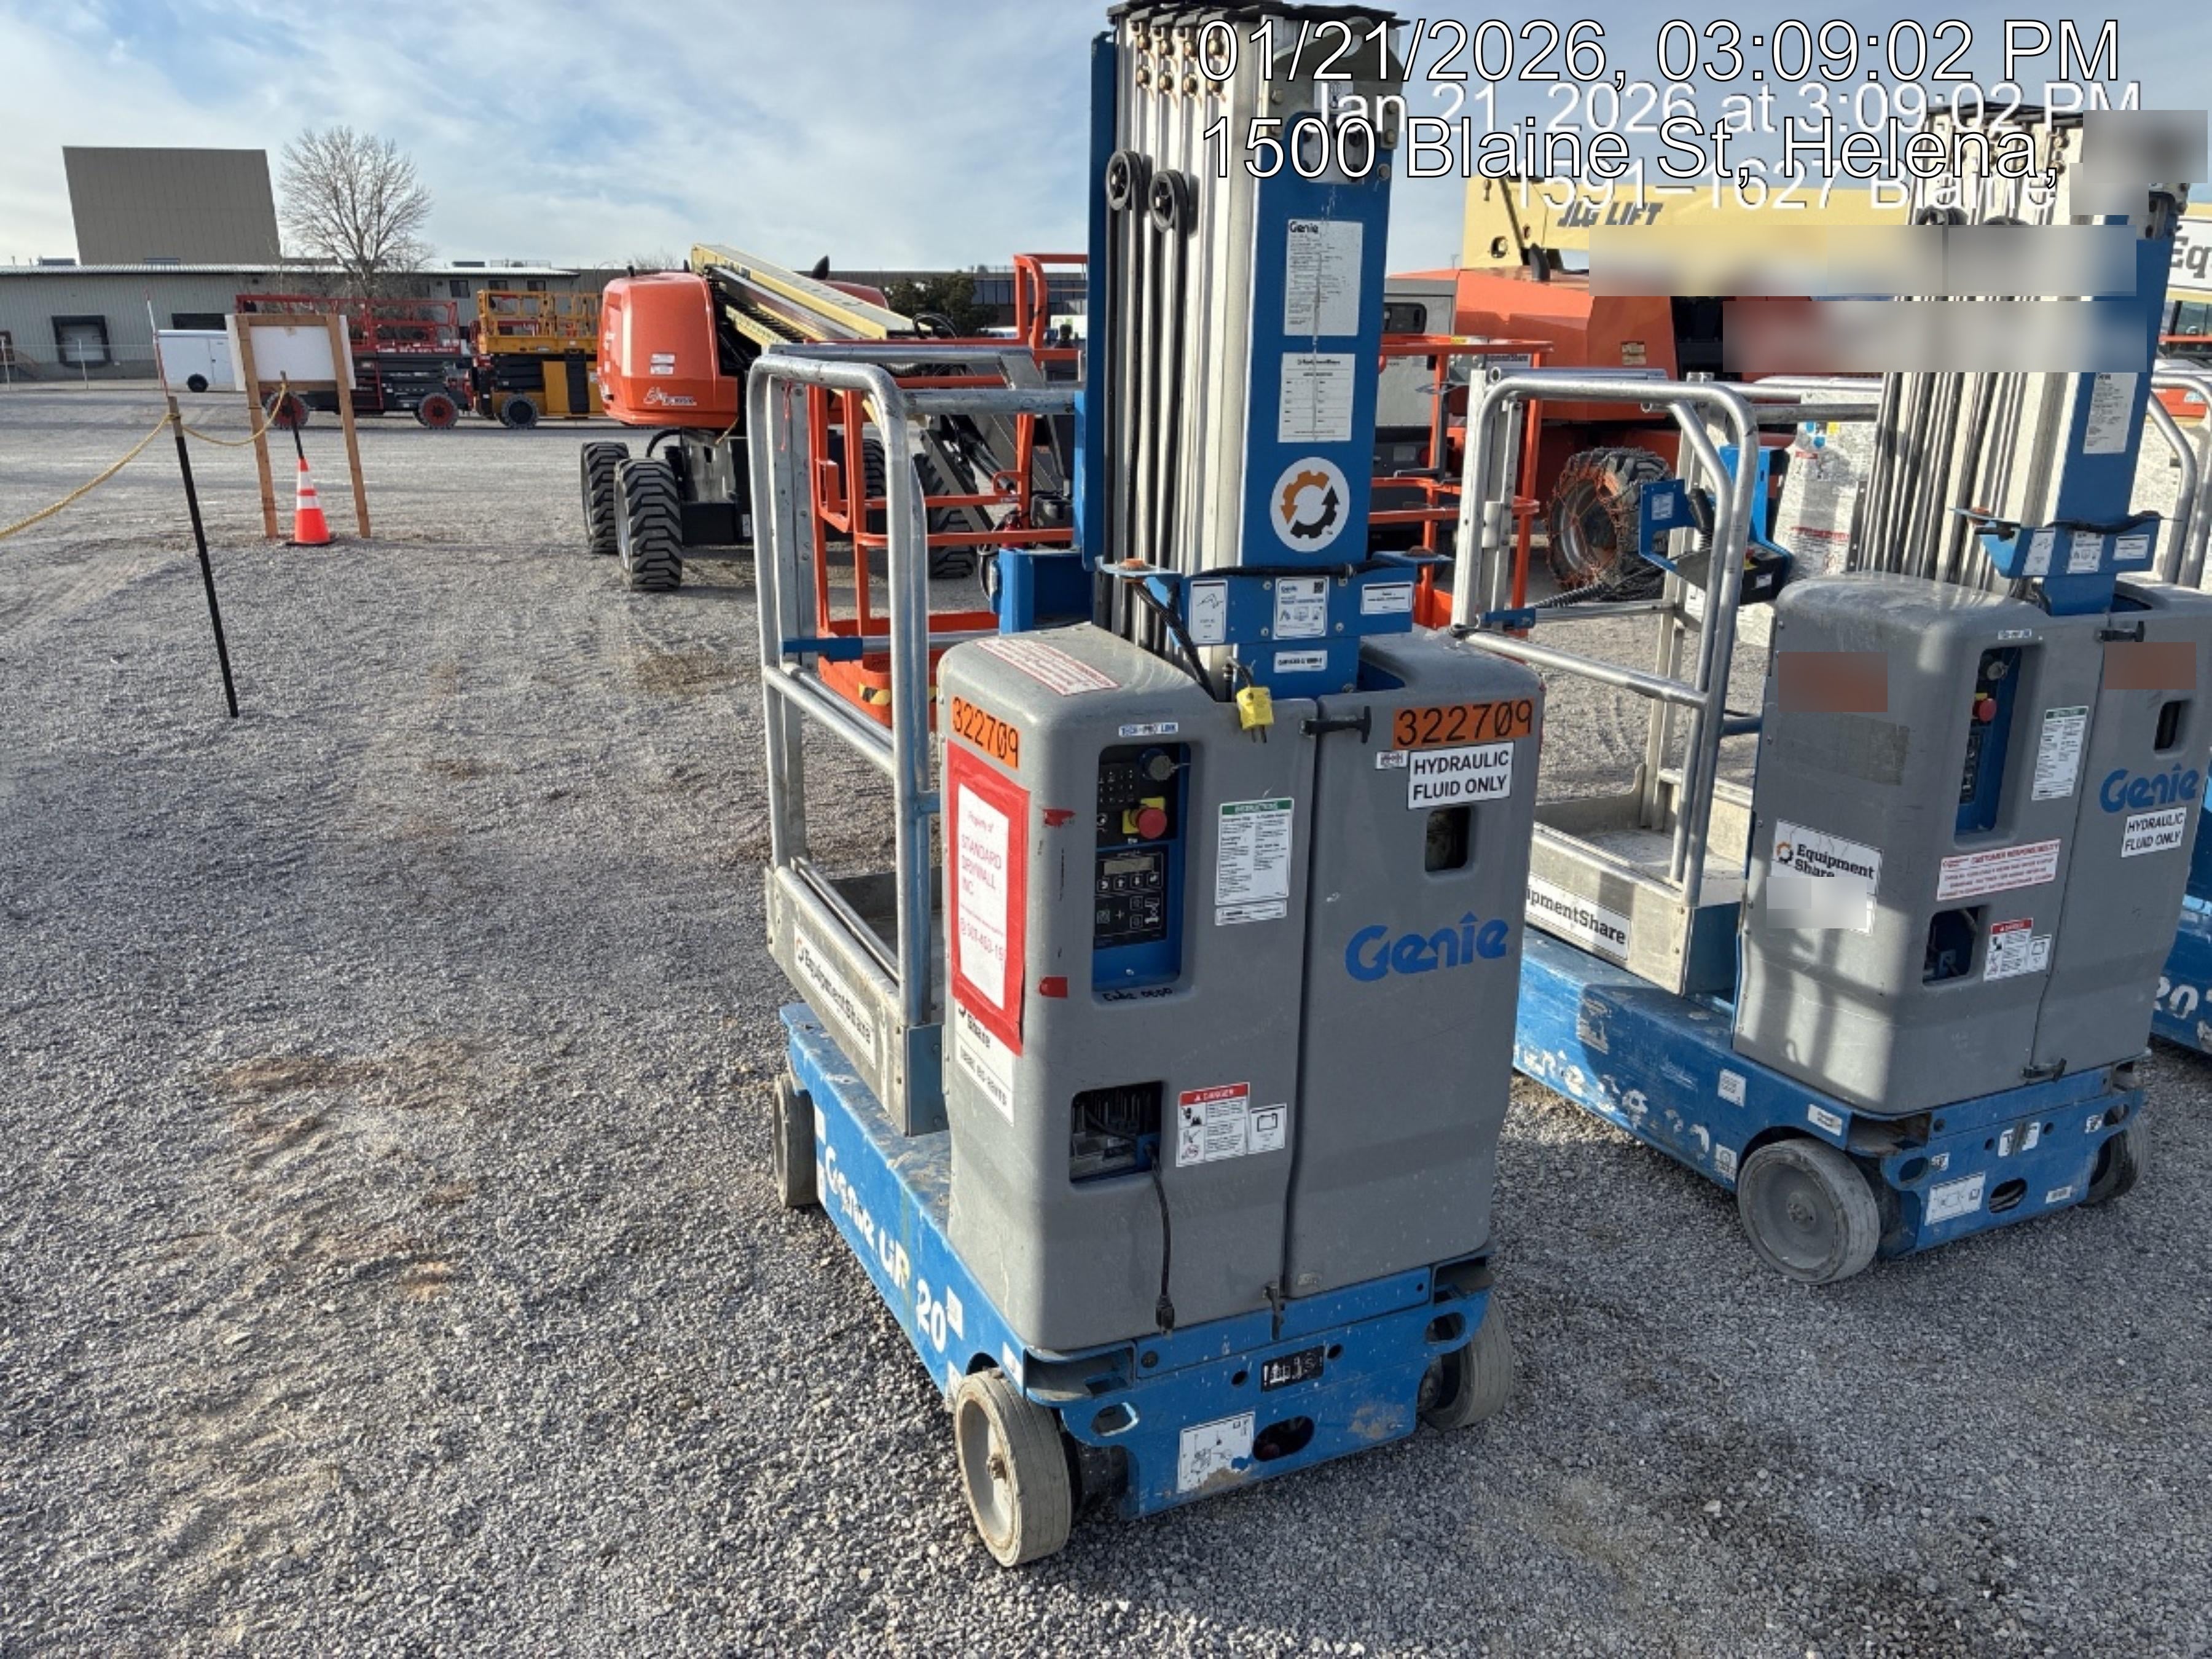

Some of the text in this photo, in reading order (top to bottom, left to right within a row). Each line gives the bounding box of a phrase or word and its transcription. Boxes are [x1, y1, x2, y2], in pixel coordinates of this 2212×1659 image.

[1290, 221, 1318, 233] Genie
[2171, 236, 2212, 278] Eq
[1397, 699, 1533, 746] 322709
[1414, 750, 1509, 775] HYDRAULIC
[1413, 774, 1507, 800] FLUID ONLY
[2101, 763, 2200, 813] Genie
[2127, 812, 2184, 833] HYDRAULIC
[2125, 830, 2181, 852] FLUID ONLY
[1795, 858, 1835, 877] Share
[1797, 843, 1875, 880] Equipment
[1345, 911, 1509, 982] Genie
[916, 1278, 947, 1353] 20
